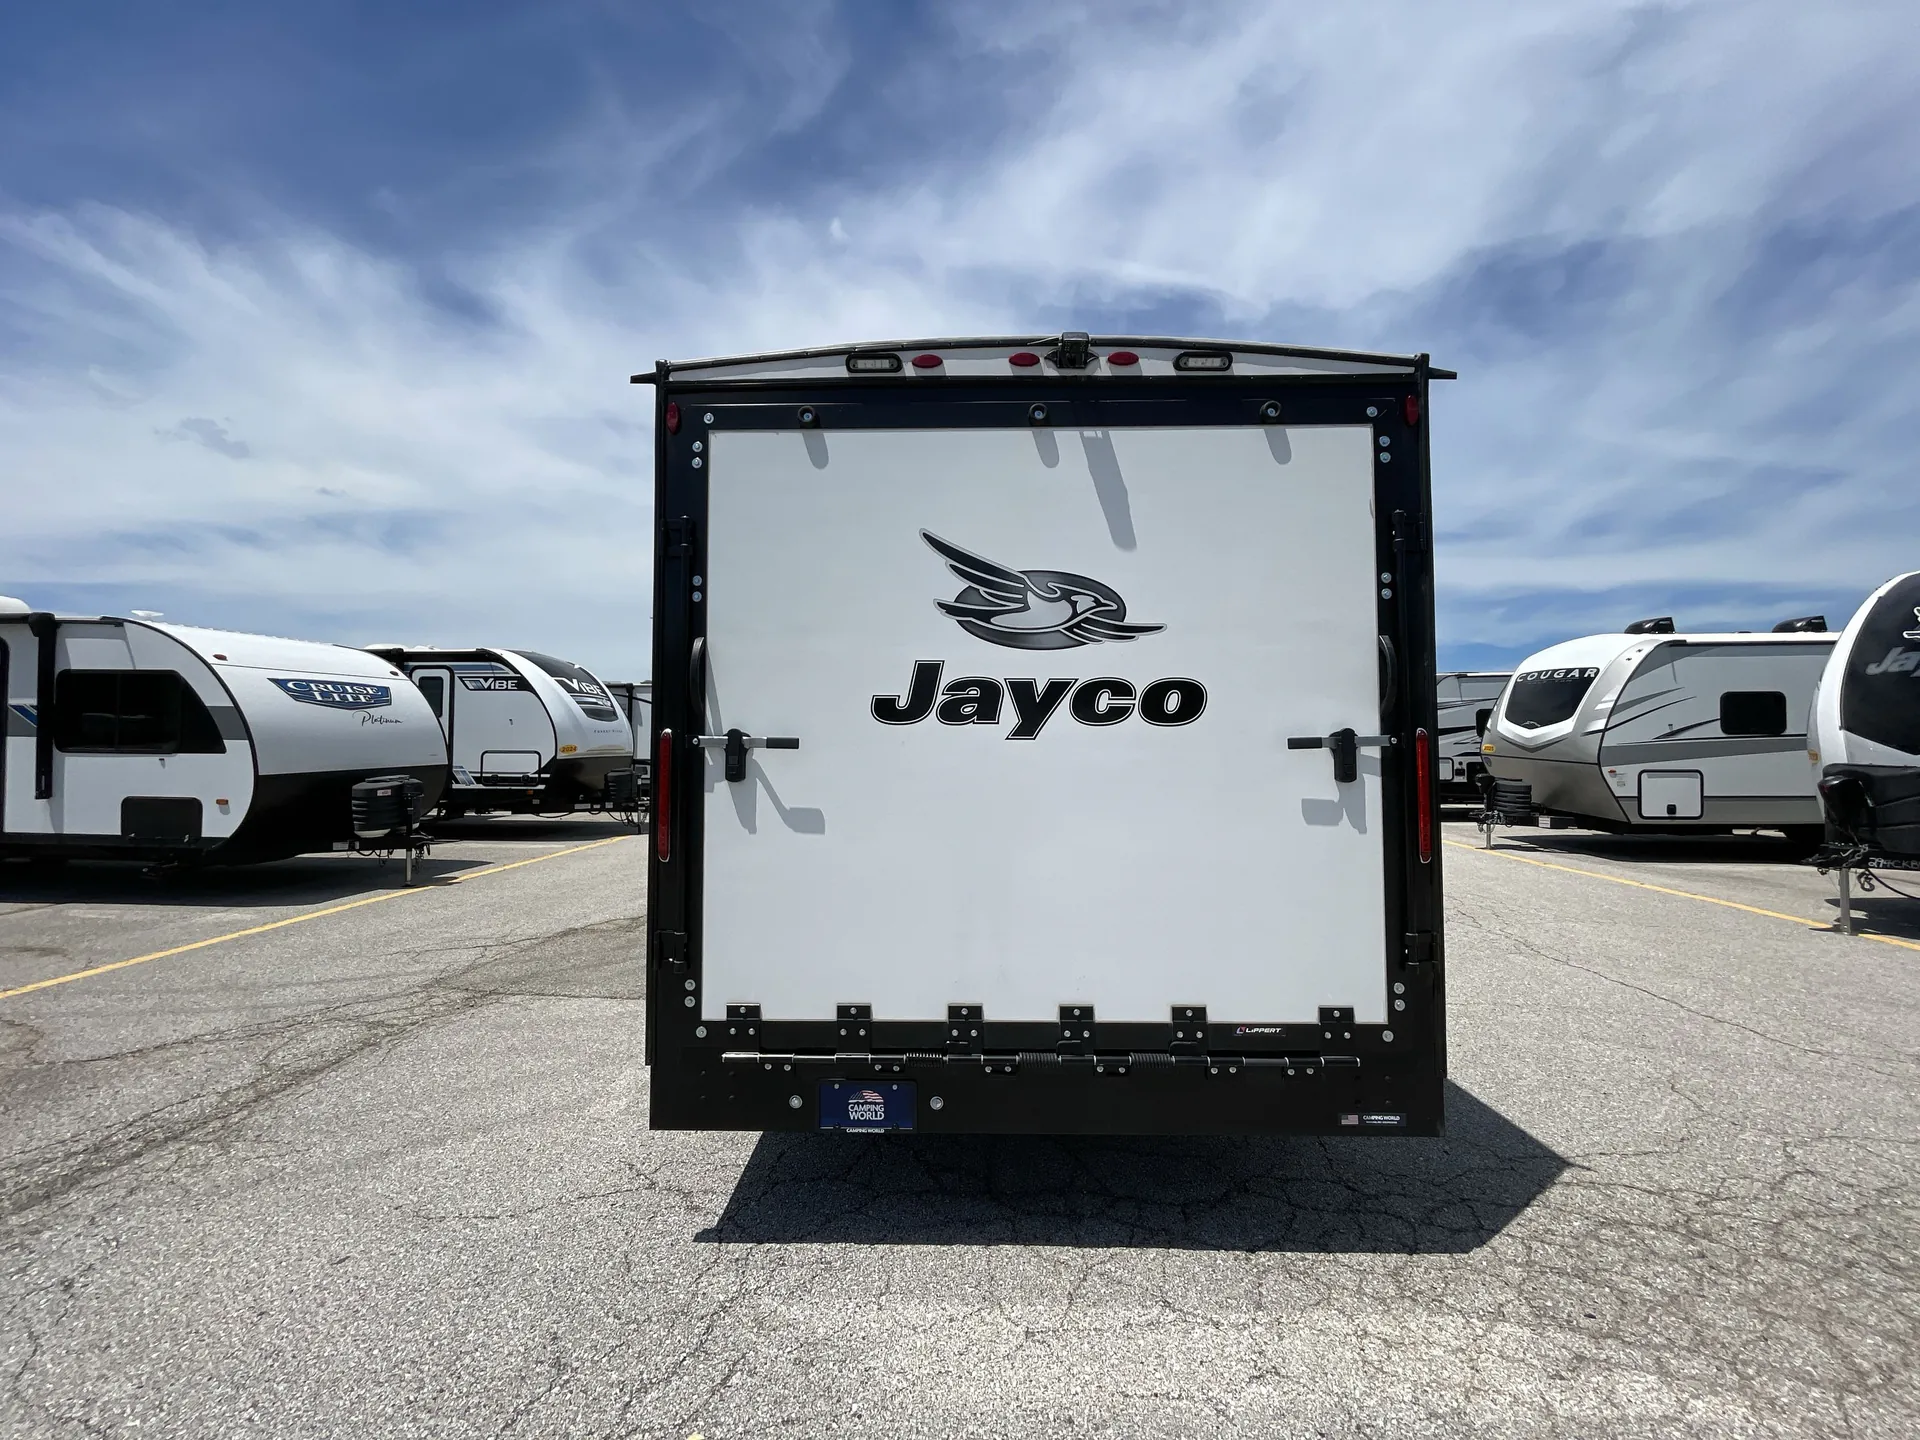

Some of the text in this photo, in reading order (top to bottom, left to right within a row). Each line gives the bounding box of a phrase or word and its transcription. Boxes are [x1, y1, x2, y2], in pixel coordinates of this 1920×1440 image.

[1517, 668, 1597, 681] COUGAR
[286, 681, 382, 695] CRUISE
[463, 678, 518, 690] VIBE
[553, 677, 606, 696] VIBE
[311, 690, 375, 703] LITE
[870, 660, 1208, 741] Jayco
[352, 710, 403, 726] Platinum
[848, 1104, 885, 1112] CAMPING
[848, 1111, 885, 1120] WORLD
